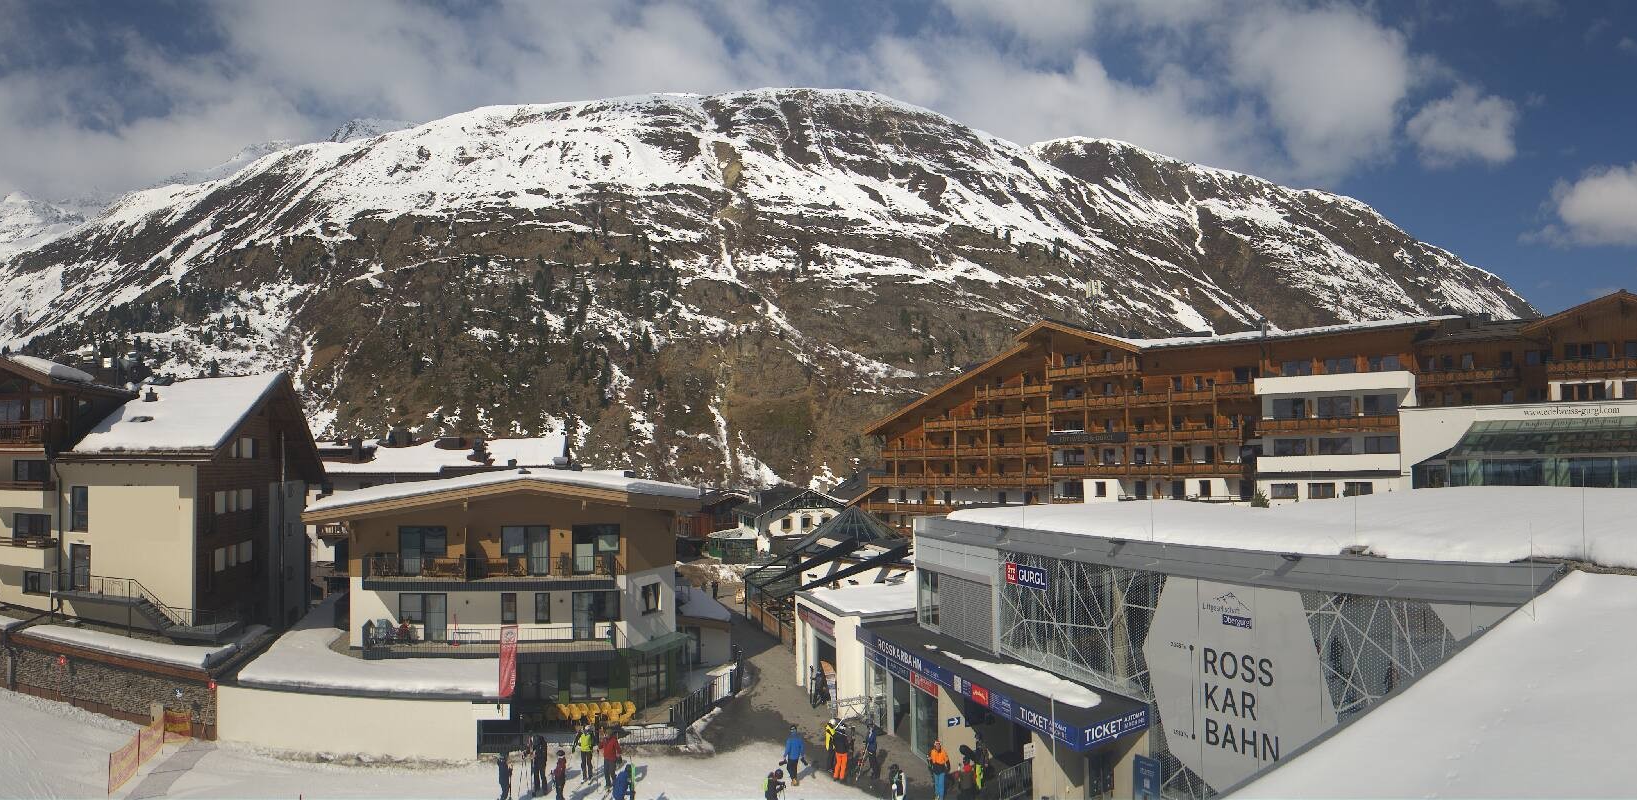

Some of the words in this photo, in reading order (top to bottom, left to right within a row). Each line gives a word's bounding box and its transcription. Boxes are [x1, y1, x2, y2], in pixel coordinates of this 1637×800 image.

[1018, 569, 1046, 586] GURGL
[877, 638, 922, 671] ROSSKARBAHN
[1204, 647, 1273, 687] ROSS
[1019, 706, 1049, 730] TICKET
[1204, 682, 1257, 721] KAR
[1084, 718, 1123, 742] TICKET
[1205, 717, 1279, 762] BAHN
